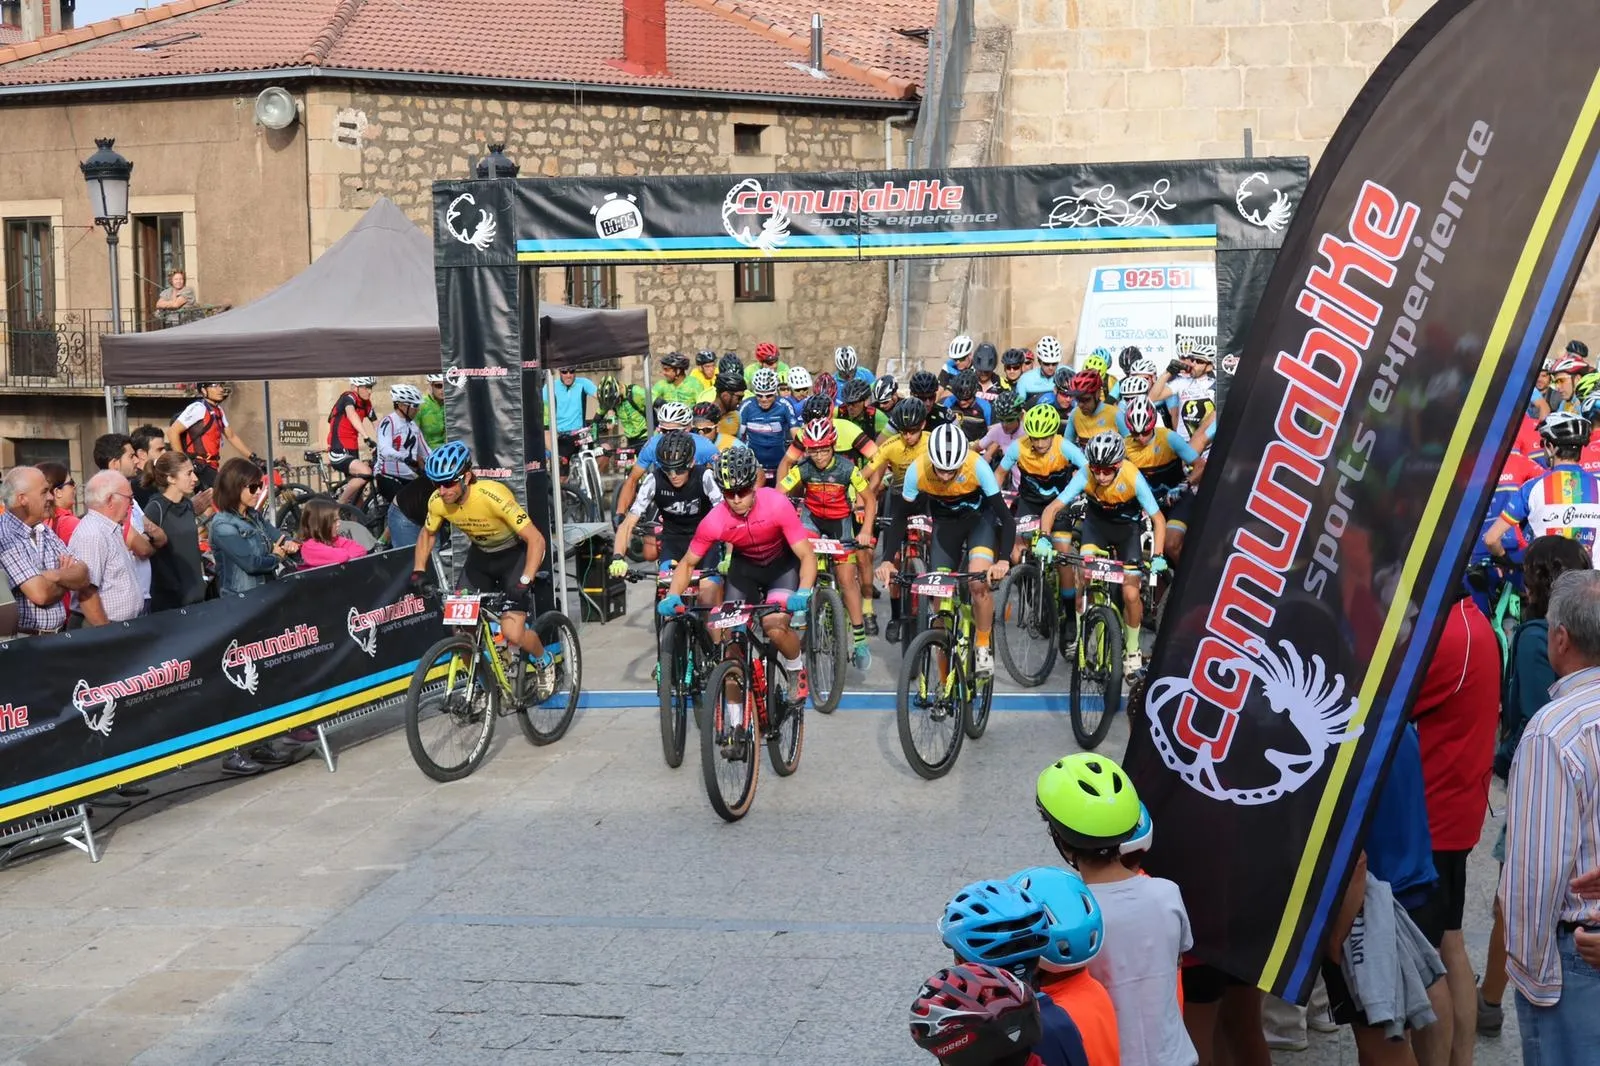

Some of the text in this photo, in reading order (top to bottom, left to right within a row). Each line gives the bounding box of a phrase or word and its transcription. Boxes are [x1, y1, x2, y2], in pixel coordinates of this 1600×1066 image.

[809, 210, 998, 230] sports experience
[1125, 269, 1191, 288] 925 51
[1303, 119, 1494, 599] sports experience
[927, 575, 942, 585] 12
[451, 603, 473, 619] 129
[263, 641, 335, 669] sports experience
[937, 1034, 970, 1055] speed
